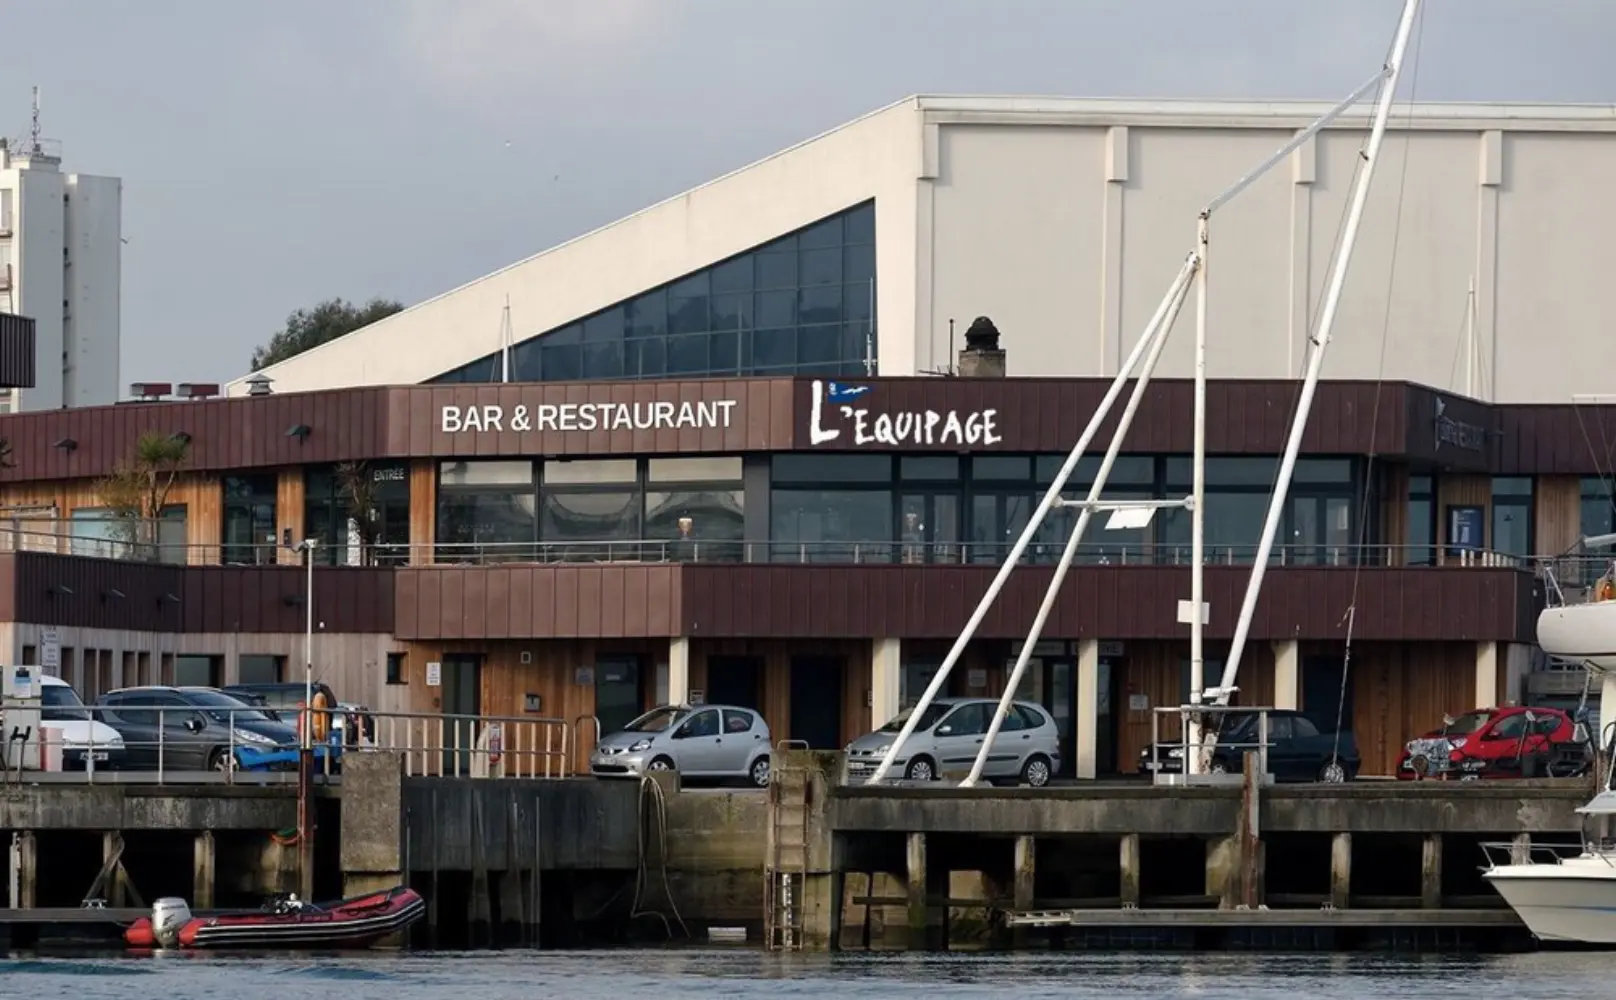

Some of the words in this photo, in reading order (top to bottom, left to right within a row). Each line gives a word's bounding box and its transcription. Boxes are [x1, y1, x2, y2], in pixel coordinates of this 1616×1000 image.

[442, 405, 503, 432] BAR
[511, 405, 531, 431] &
[538, 400, 736, 431] RESTAURANT
[811, 380, 1002, 446] L'EQUIPAGE
